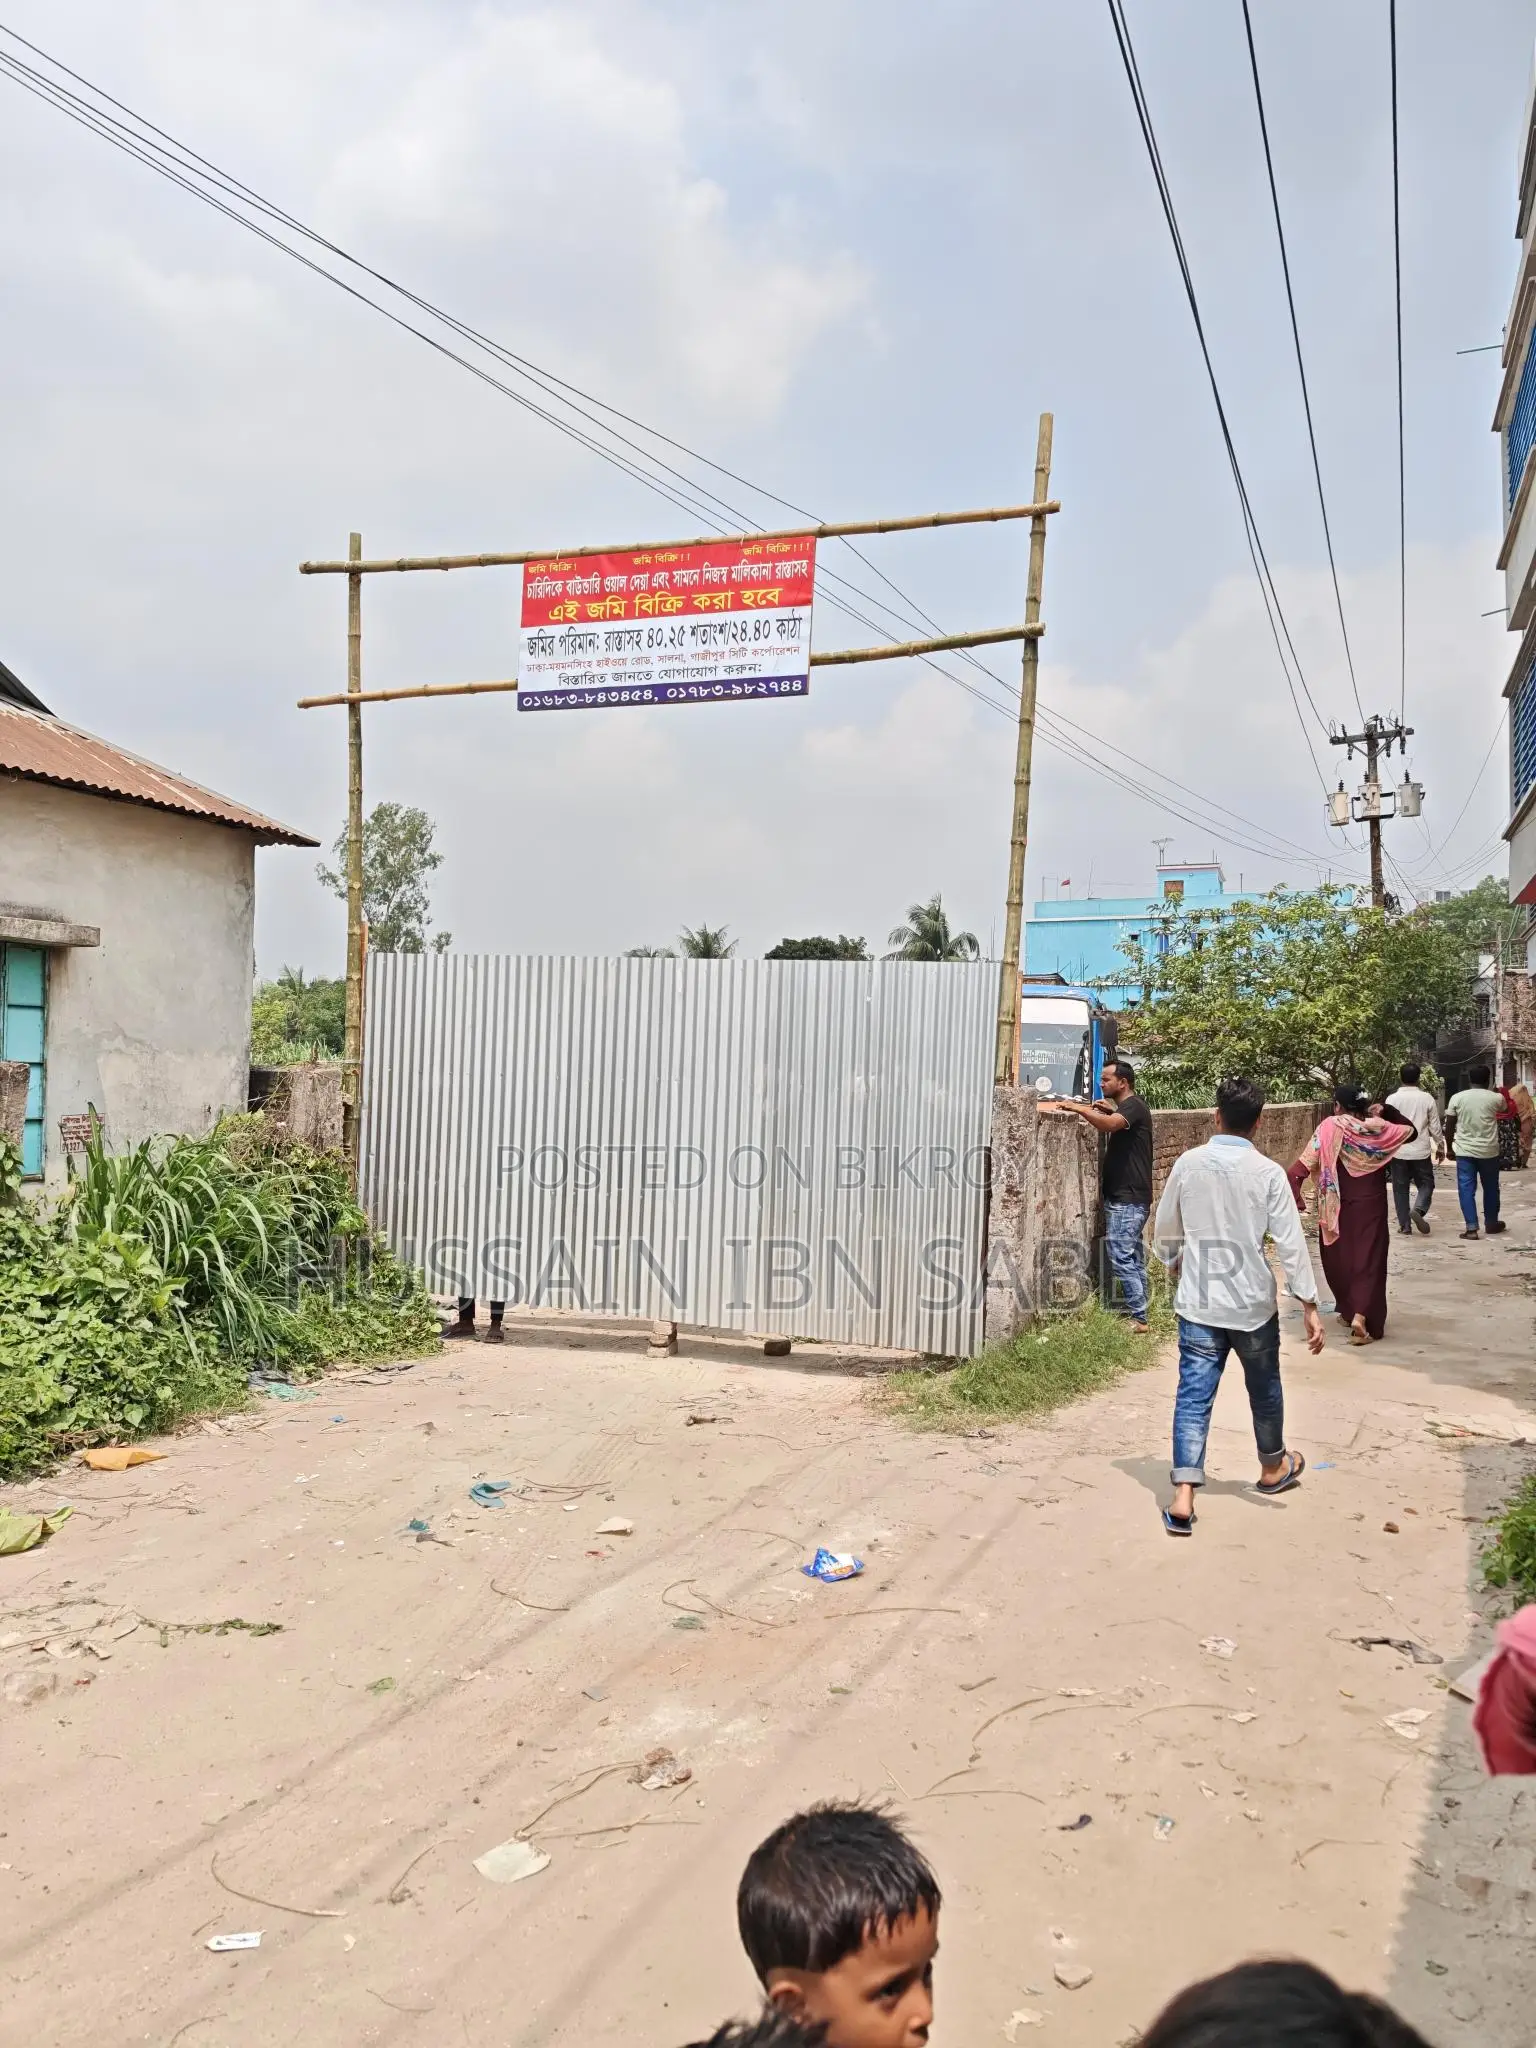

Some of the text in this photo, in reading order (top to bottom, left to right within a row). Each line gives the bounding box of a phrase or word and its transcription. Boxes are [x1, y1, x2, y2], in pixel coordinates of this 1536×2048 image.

[632, 555, 652, 565] জমি
[742, 545, 763, 556] জমি
[528, 565, 546, 574] জমি
[604, 573, 628, 593] ওয়াল
[630, 572, 650, 591] দেয়া
[652, 571, 670, 589] এবং
[673, 568, 700, 587] সামনে
[702, 561, 729, 585] নিজস্ব
[731, 559, 773, 583] মালিকানা
[775, 559, 809, 579] রাস্তাসহ
[548, 587, 784, 622] এই জমি বিক্রি করা হবে
[527, 628, 555, 659] জমির
[558, 626, 600, 656] পরিমান:
[604, 626, 643, 653] রাস্তাসহ
[647, 623, 686, 650] ৪০.২৫
[775, 608, 803, 640] কাঠা
[596, 657, 629, 668] হাইওয়ে
[690, 649, 725, 661] গাজীপুর
[729, 647, 748, 658] সিটি
[558, 663, 762, 686] বিস্তারিত জানতে যোগাযোগ করুন:
[666, 680, 802, 698] ০১৭৮৩-৯৮২৭৪৪
